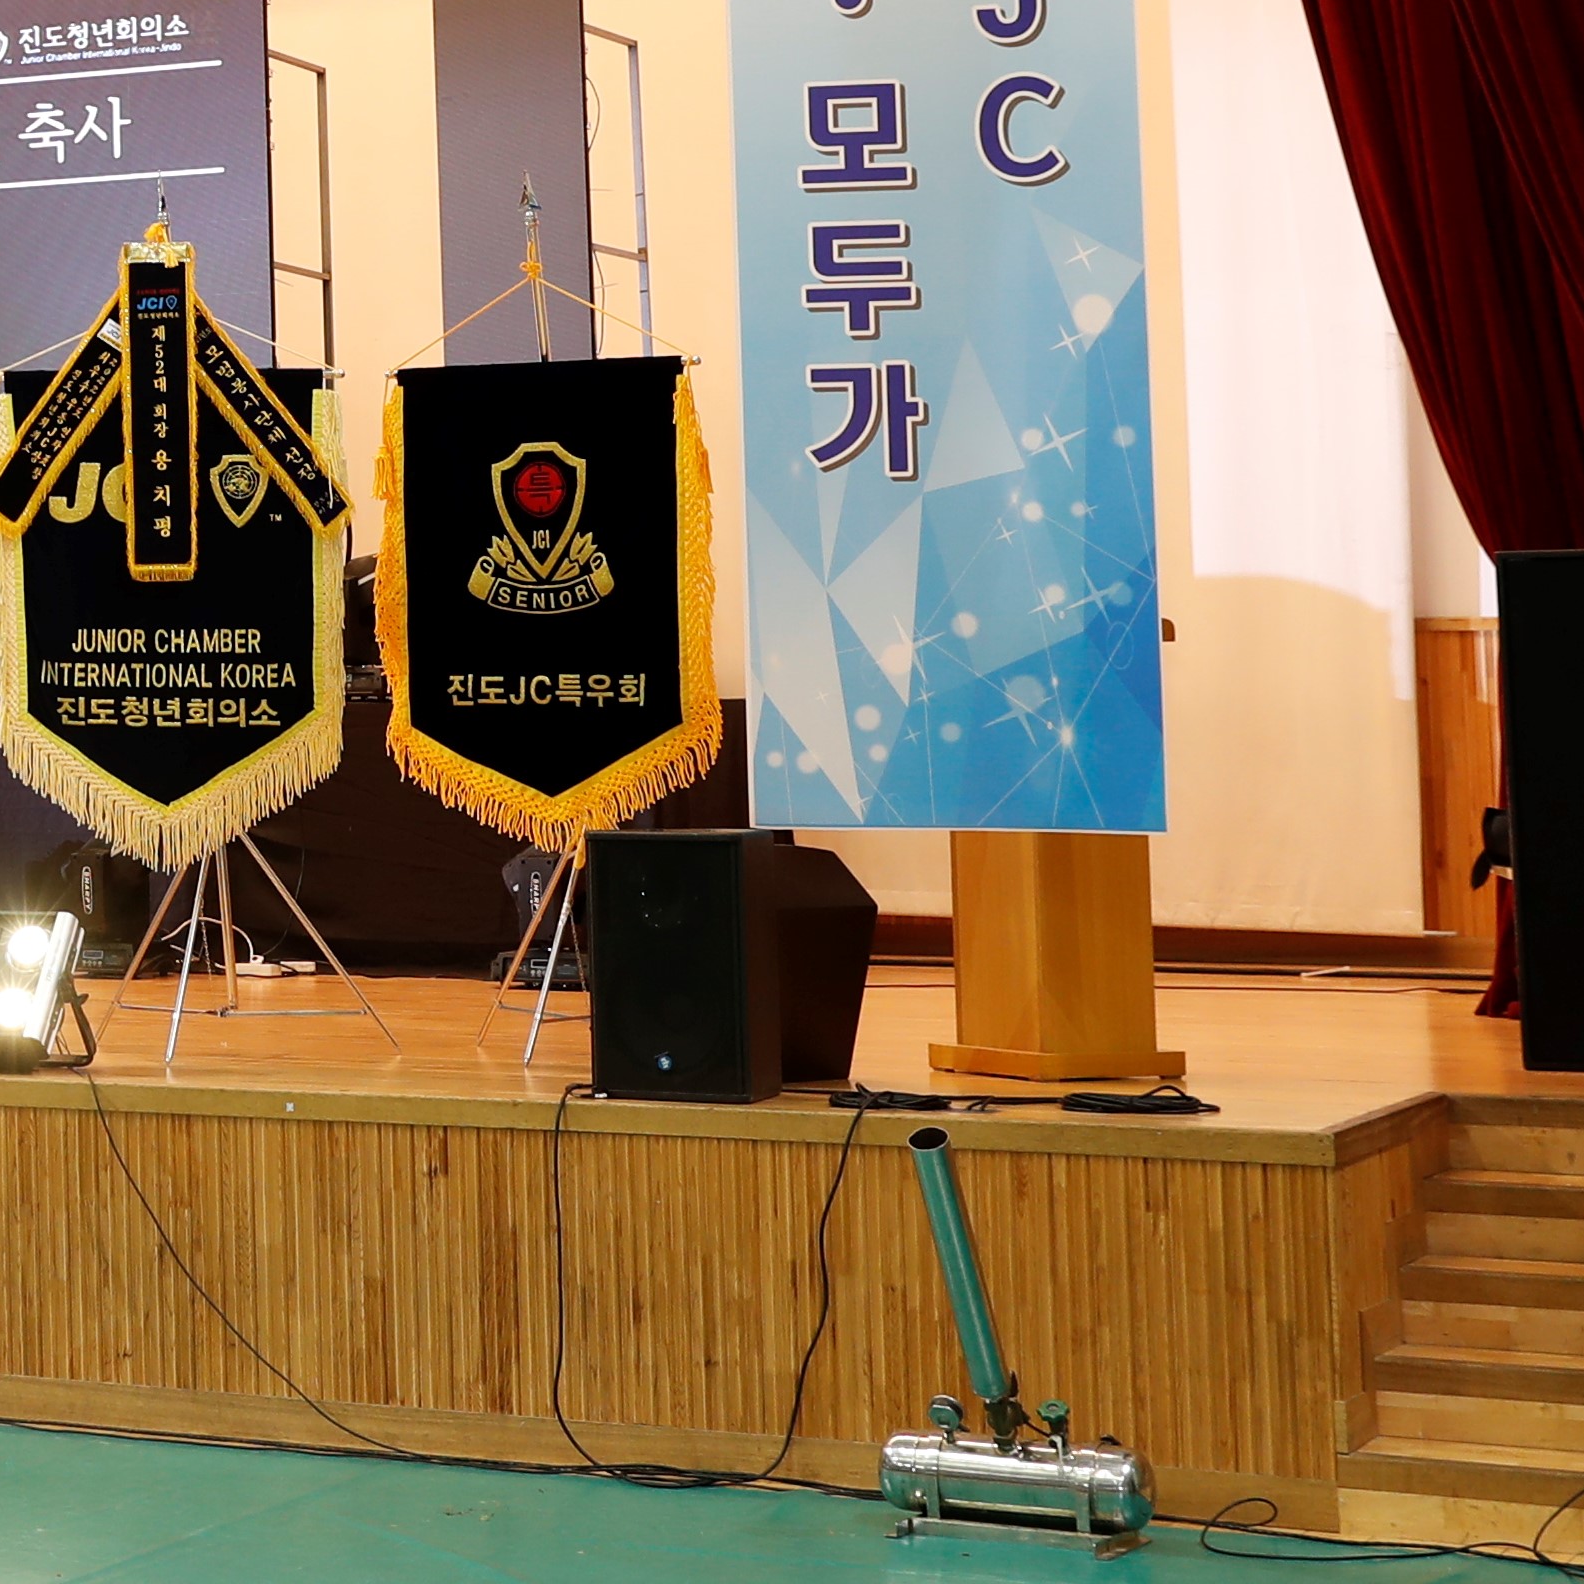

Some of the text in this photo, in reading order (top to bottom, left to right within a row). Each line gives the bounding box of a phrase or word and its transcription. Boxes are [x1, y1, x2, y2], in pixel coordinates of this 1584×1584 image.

[18, 14, 190, 55] 진도청년회의소
[17, 95, 133, 163] 축사
[136, 297, 164, 310] JCI
[204, 344, 316, 481] 모범봉사단체 선정
[531, 529, 551, 550] JCI
[497, 584, 590, 610] SENIOR
[71, 628, 262, 654] JUNIOR CHAMBER
[40, 659, 297, 689] INTERNATIONAL KOREA
[447, 672, 646, 707] 진도JC특우회
[56, 695, 281, 728] 진도청년회의소
